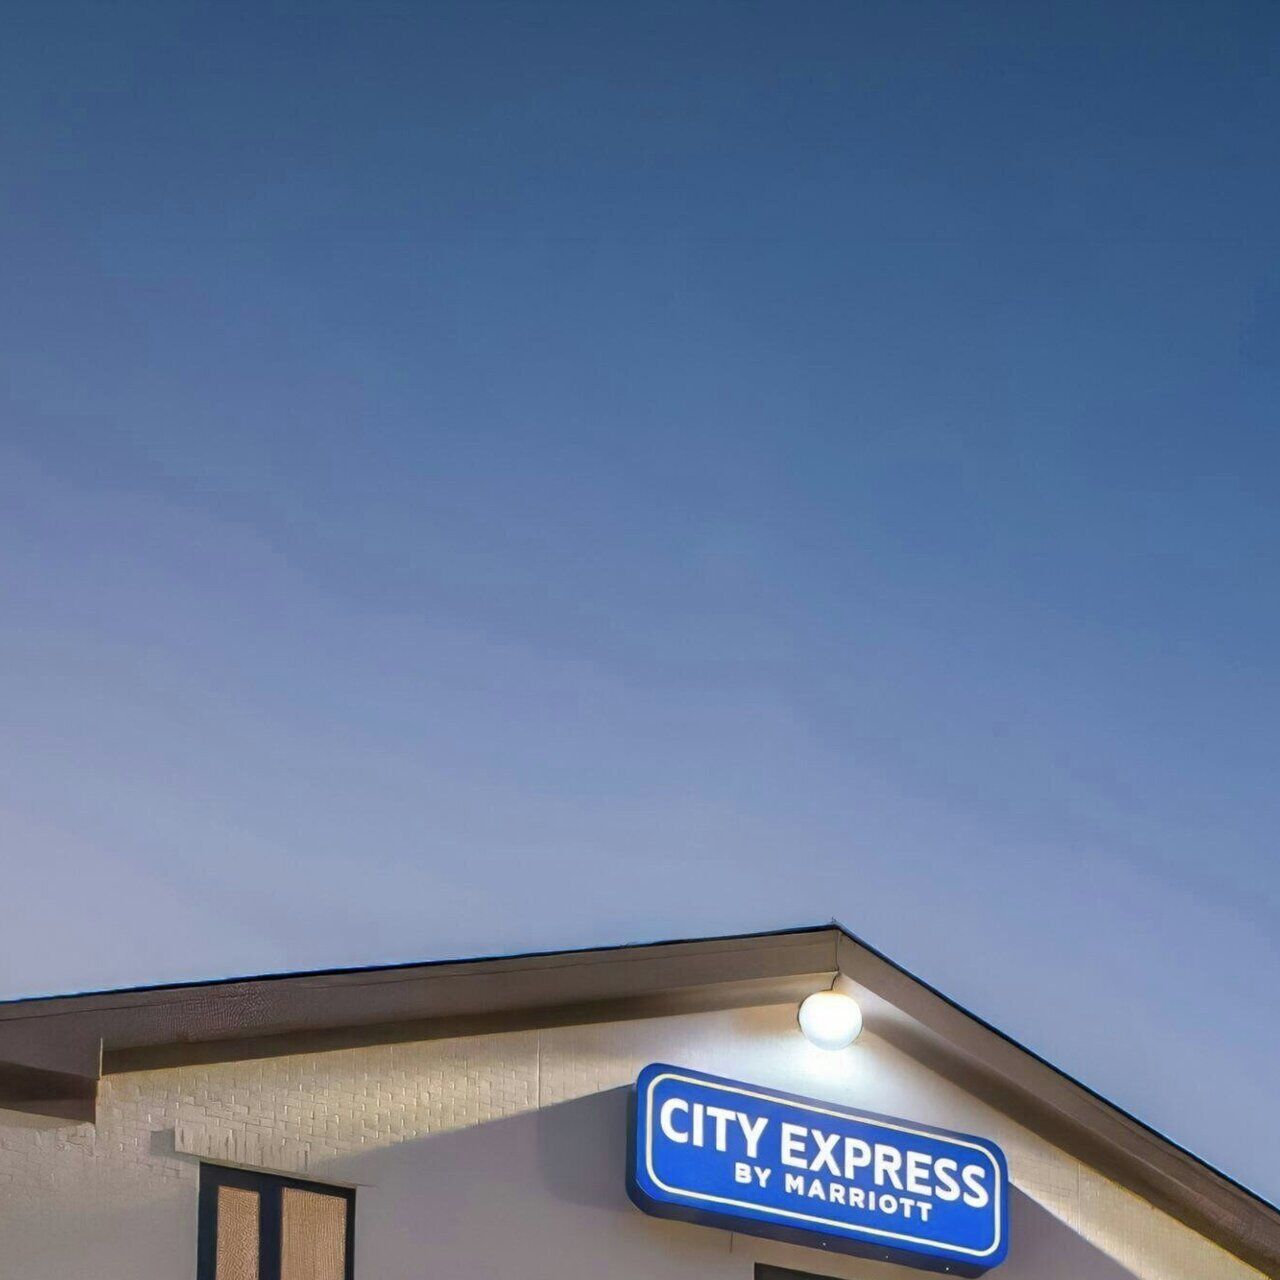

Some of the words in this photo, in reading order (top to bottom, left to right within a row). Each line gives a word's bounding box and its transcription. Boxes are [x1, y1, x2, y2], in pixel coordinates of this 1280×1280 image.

[660, 1098, 769, 1158] CITY
[781, 1123, 989, 1208] EXPRESS
[735, 1163, 771, 1188] BY
[785, 1173, 933, 1222] MARRIOTT
